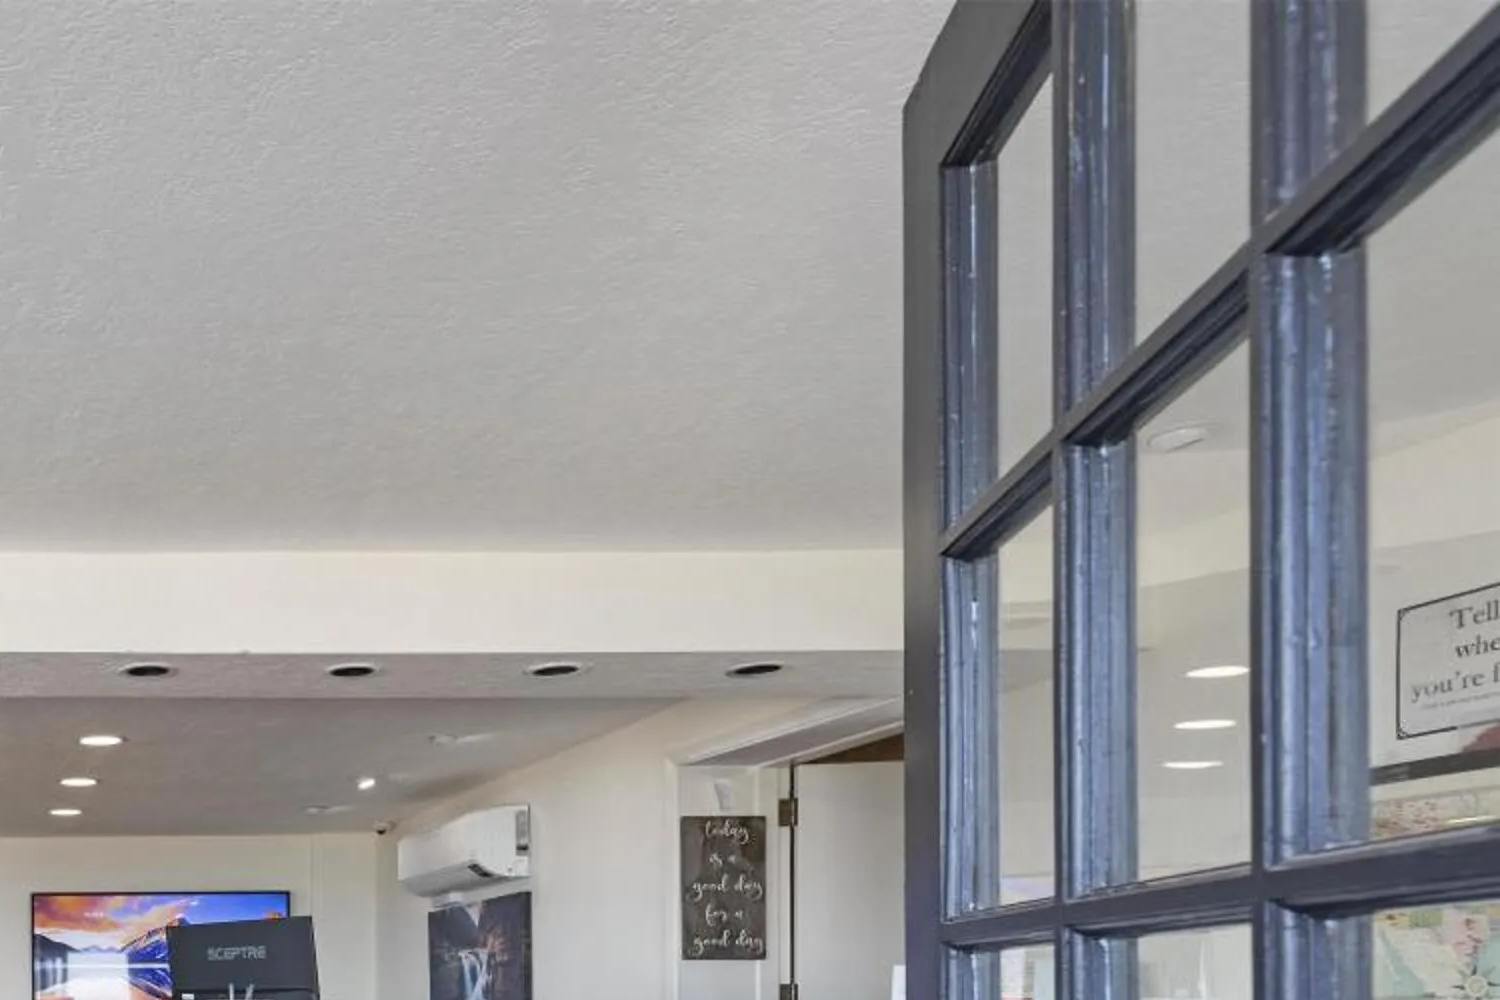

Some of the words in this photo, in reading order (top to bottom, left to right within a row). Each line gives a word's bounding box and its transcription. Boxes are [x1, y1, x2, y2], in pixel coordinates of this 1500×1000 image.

[1448, 599, 1500, 630] Tell
[1411, 670, 1485, 703] you're
[691, 874, 729, 902] good
[733, 874, 763, 901] day
[206, 945, 267, 961] SCEPTRE
[692, 928, 731, 956] good
[735, 929, 763, 955] day
